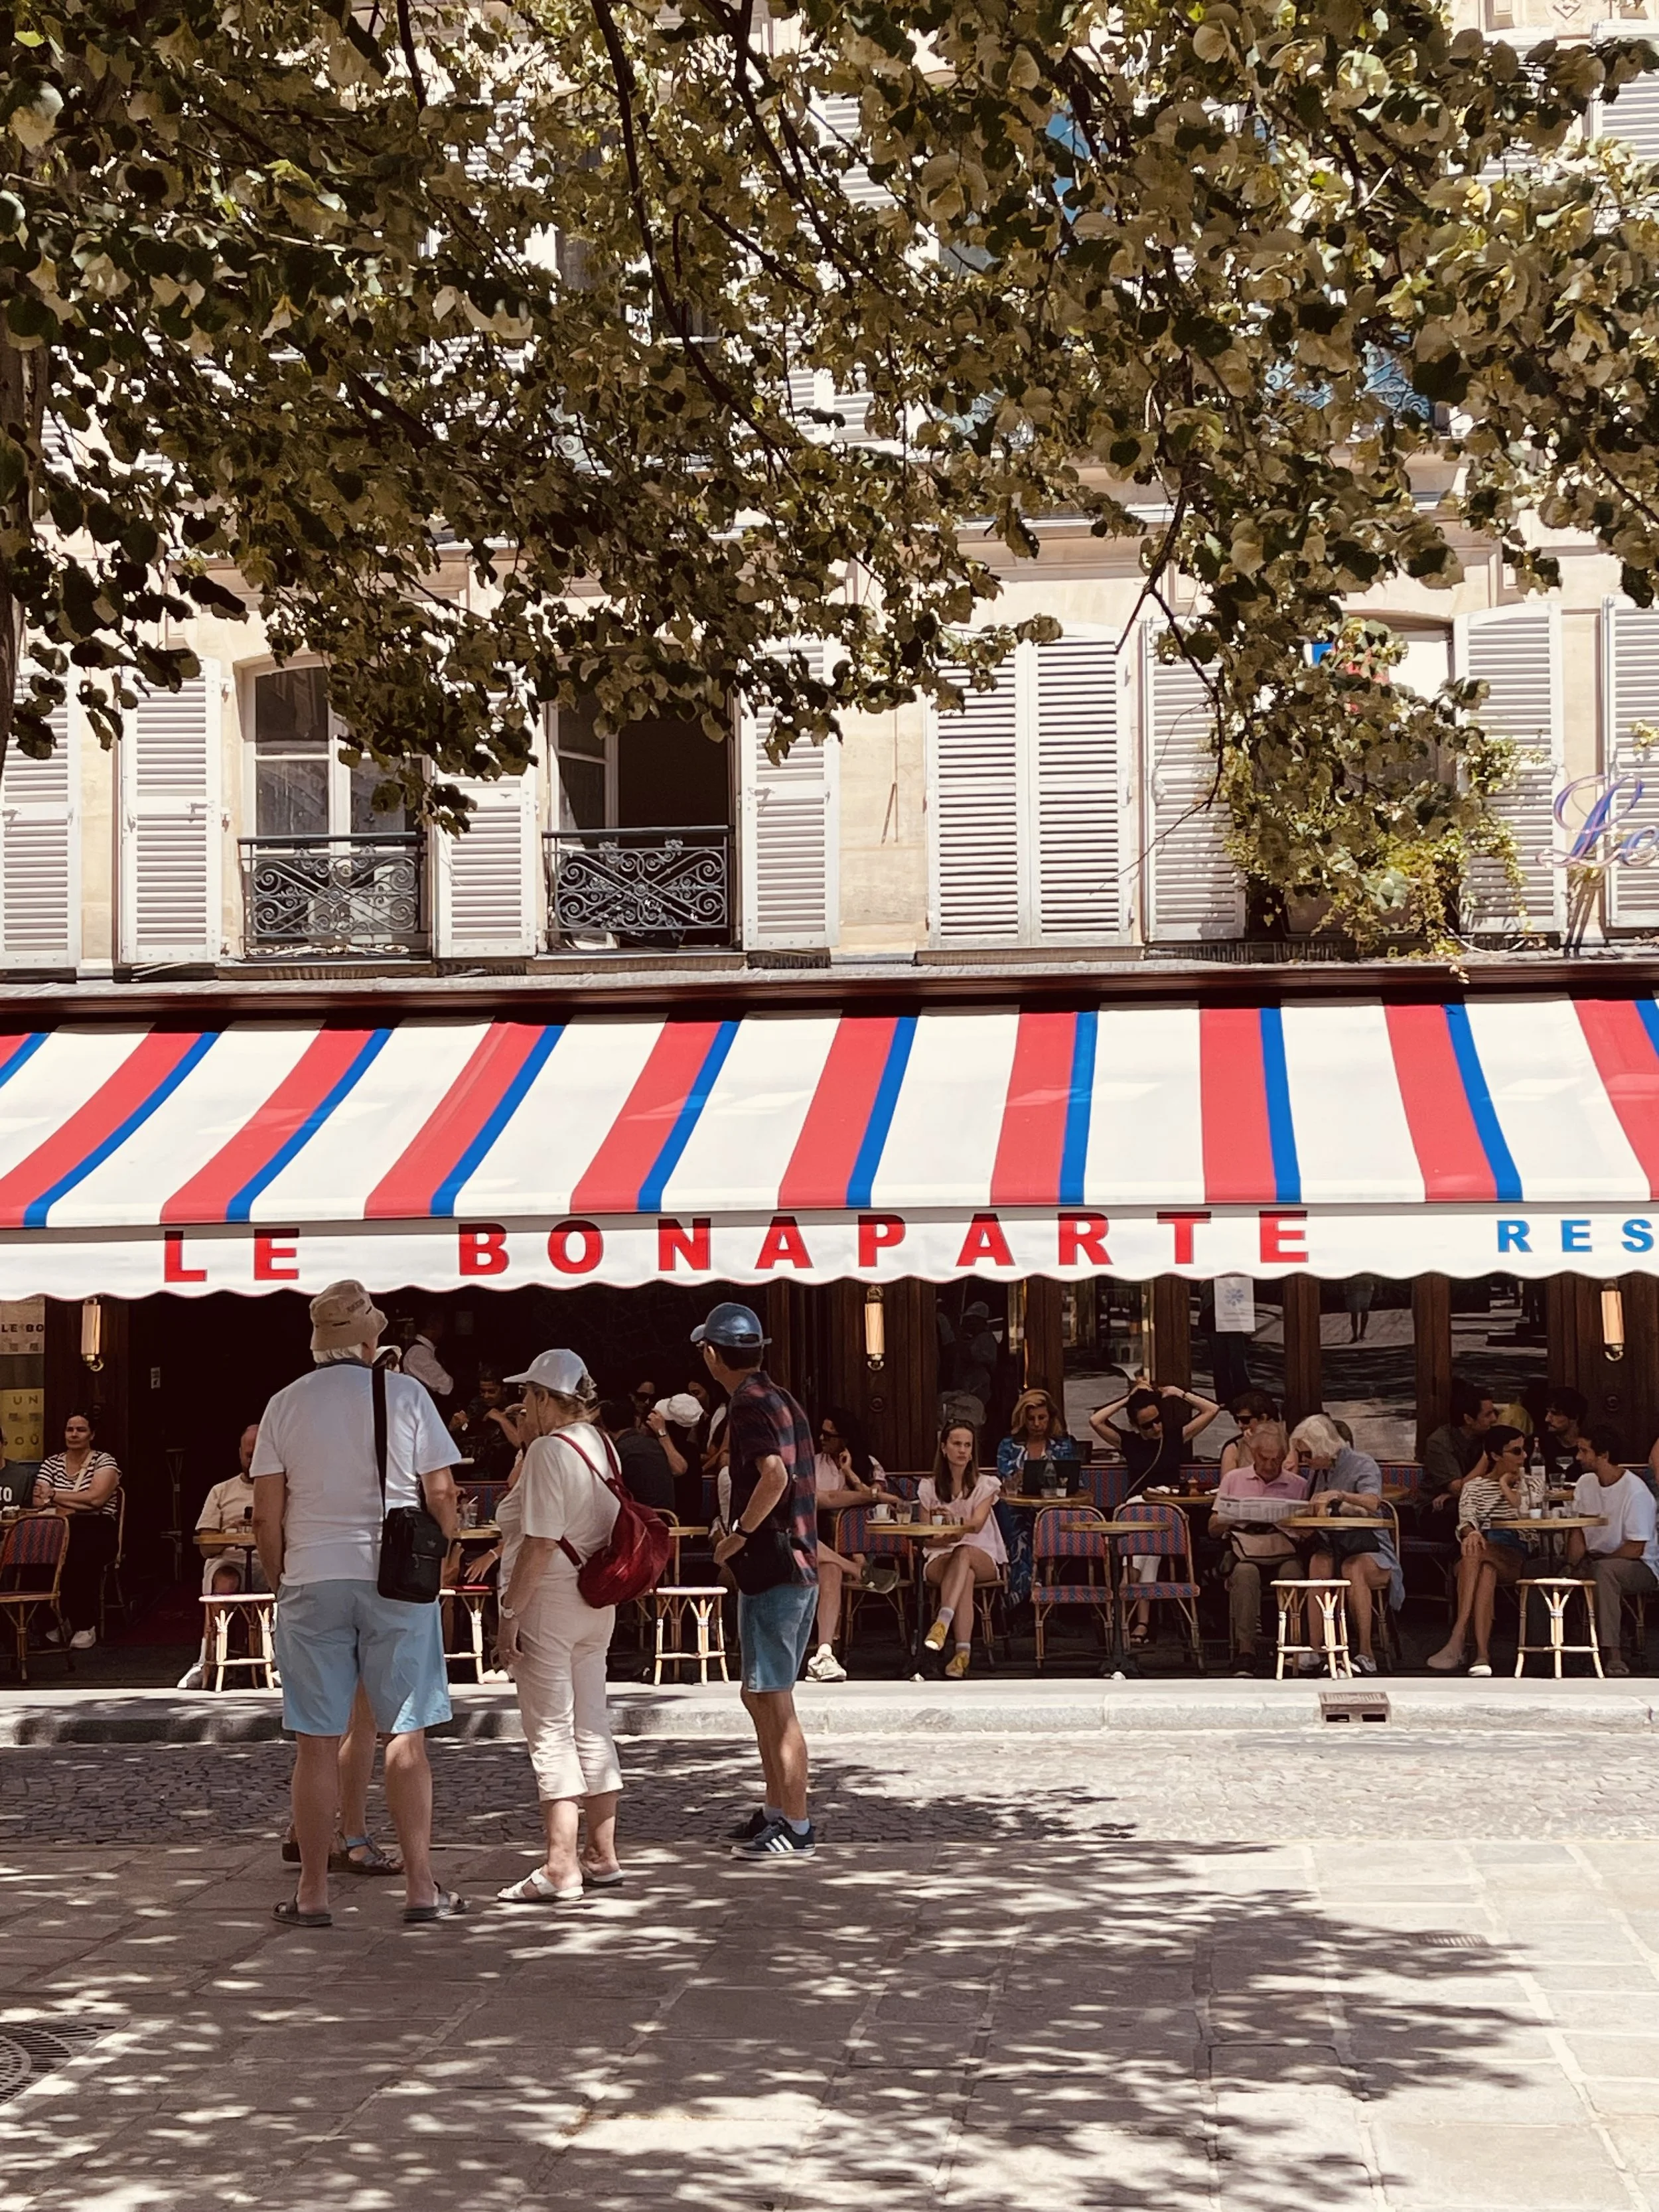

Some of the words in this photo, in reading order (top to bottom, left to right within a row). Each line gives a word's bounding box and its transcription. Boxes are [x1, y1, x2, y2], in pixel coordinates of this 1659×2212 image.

[164, 1228, 300, 1283] LE
[459, 1211, 1309, 1277] BONAPARTE
[1496, 1219, 1654, 1252] RES
